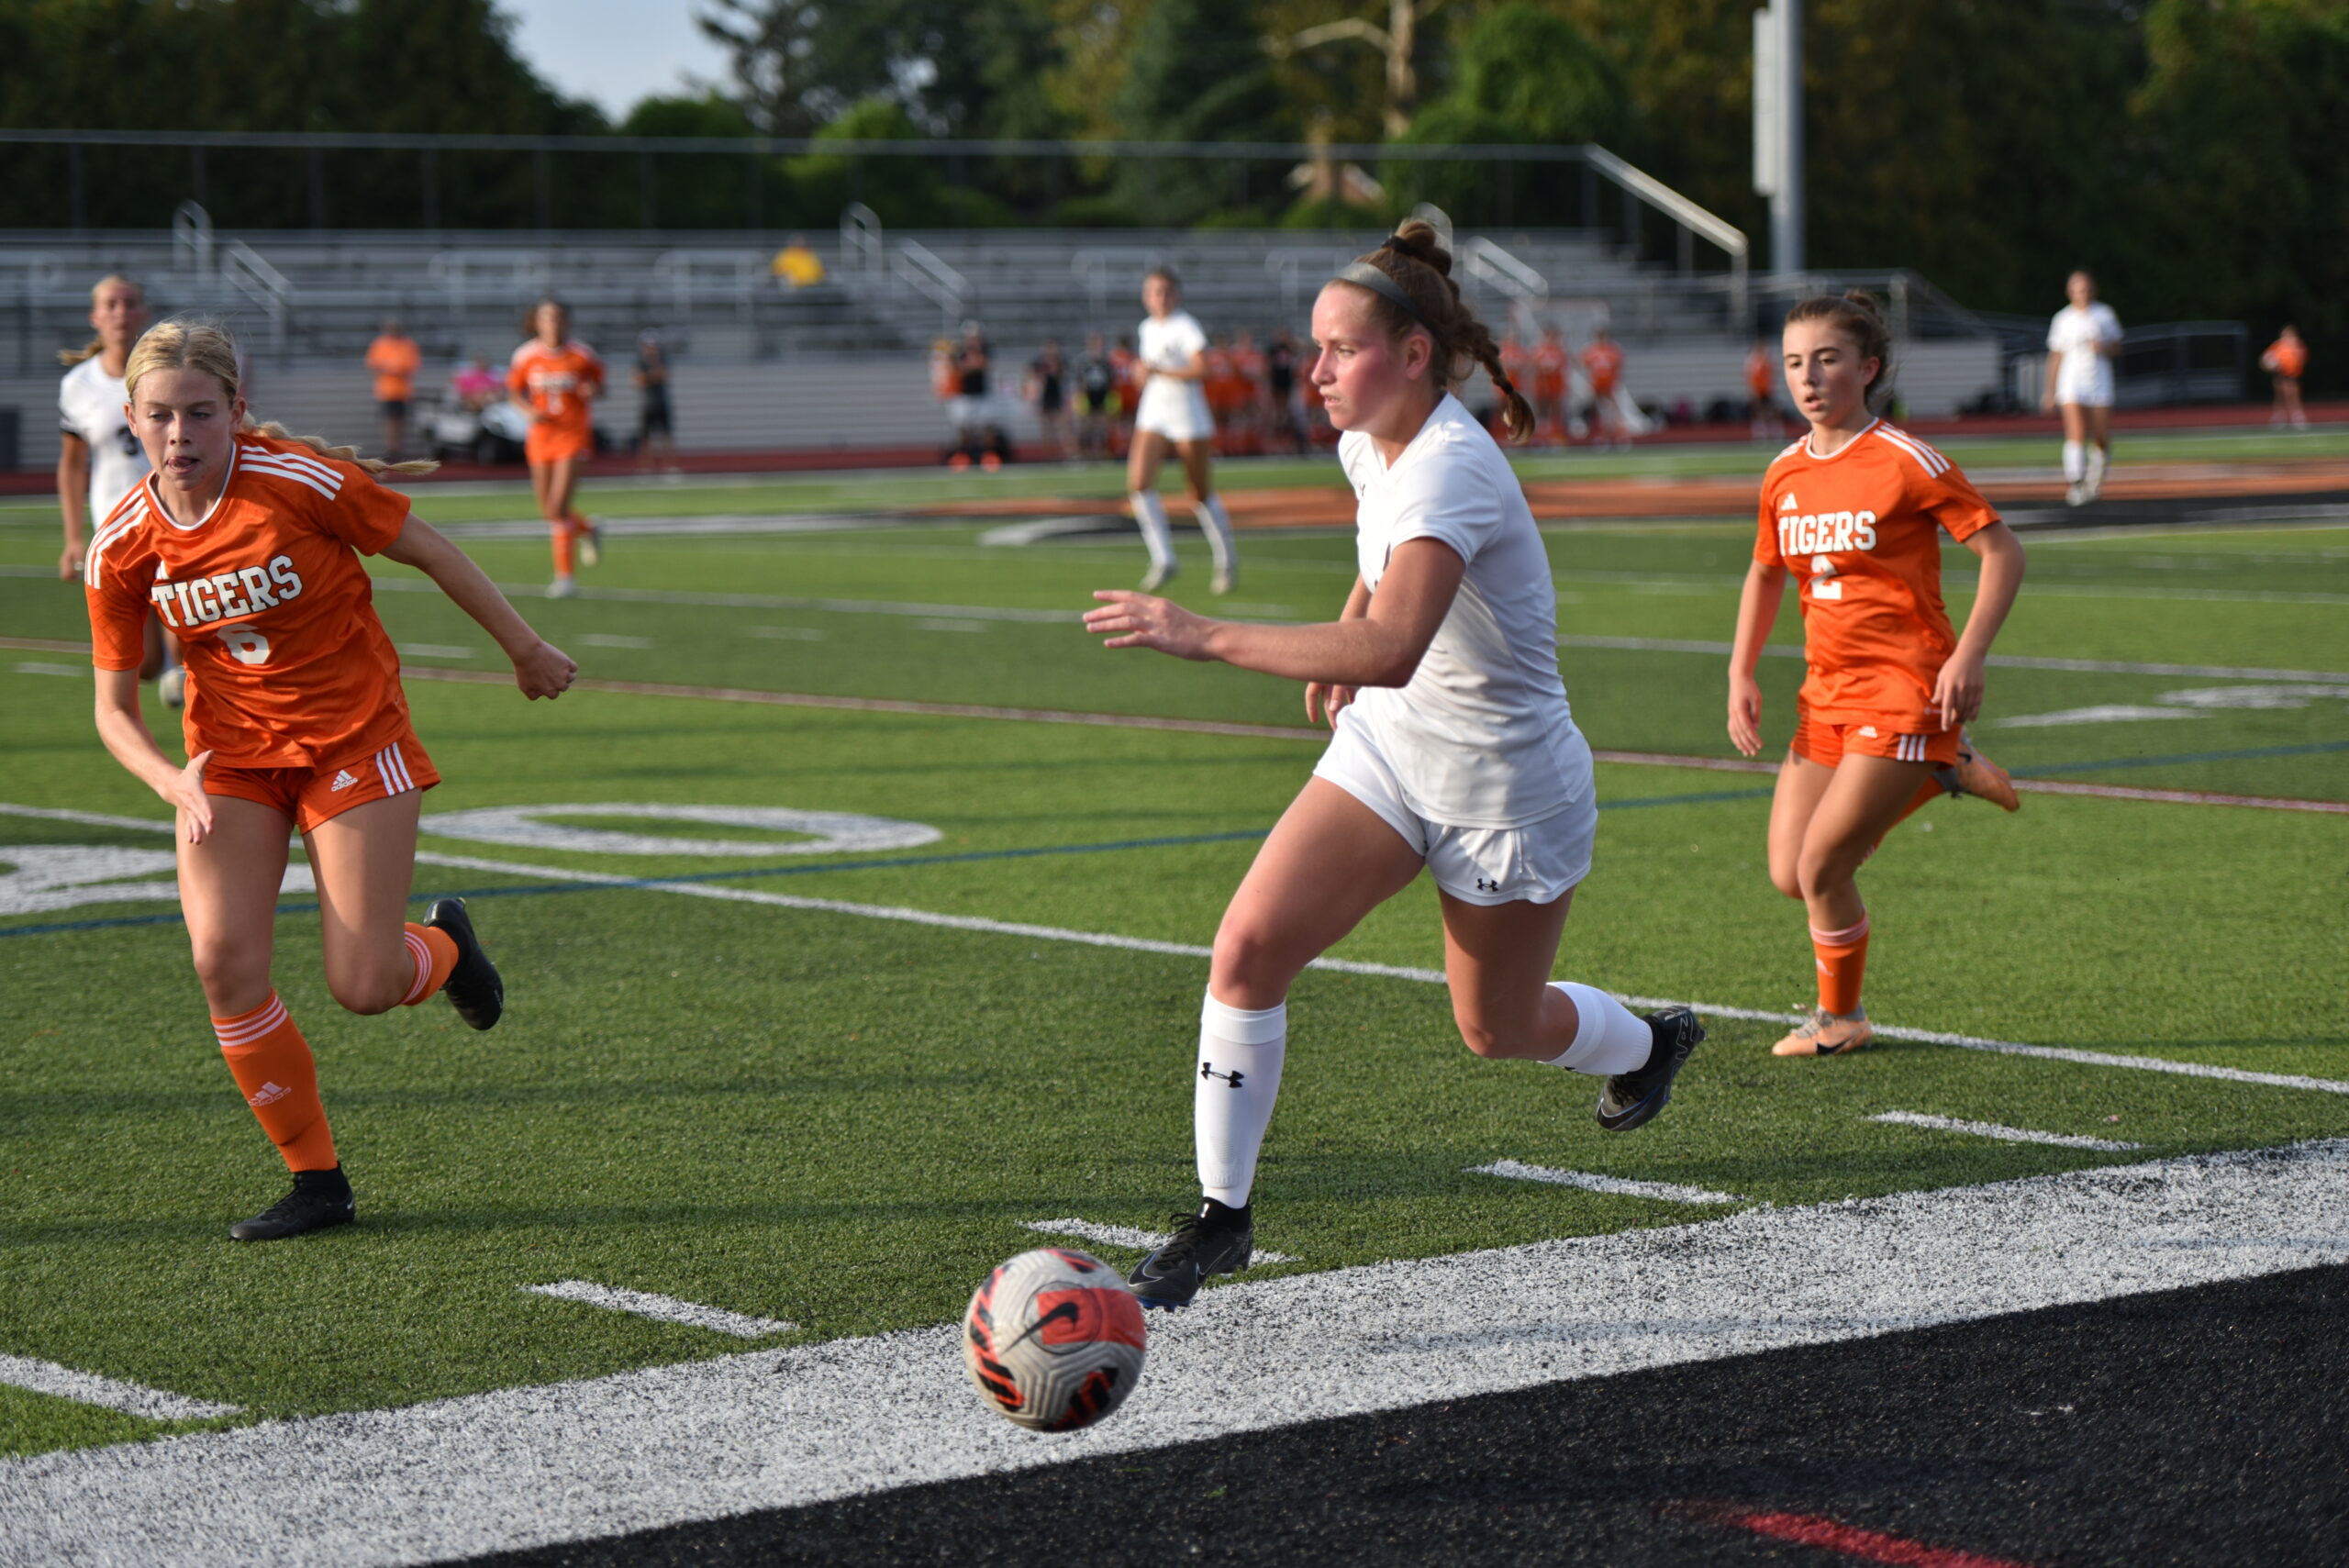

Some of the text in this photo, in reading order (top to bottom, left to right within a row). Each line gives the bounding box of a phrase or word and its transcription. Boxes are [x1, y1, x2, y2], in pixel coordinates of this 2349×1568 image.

[1778, 510, 1876, 557] TIGERS
[150, 554, 303, 628] TIGERS
[1810, 555, 1842, 600] 2
[216, 623, 270, 664] 6
